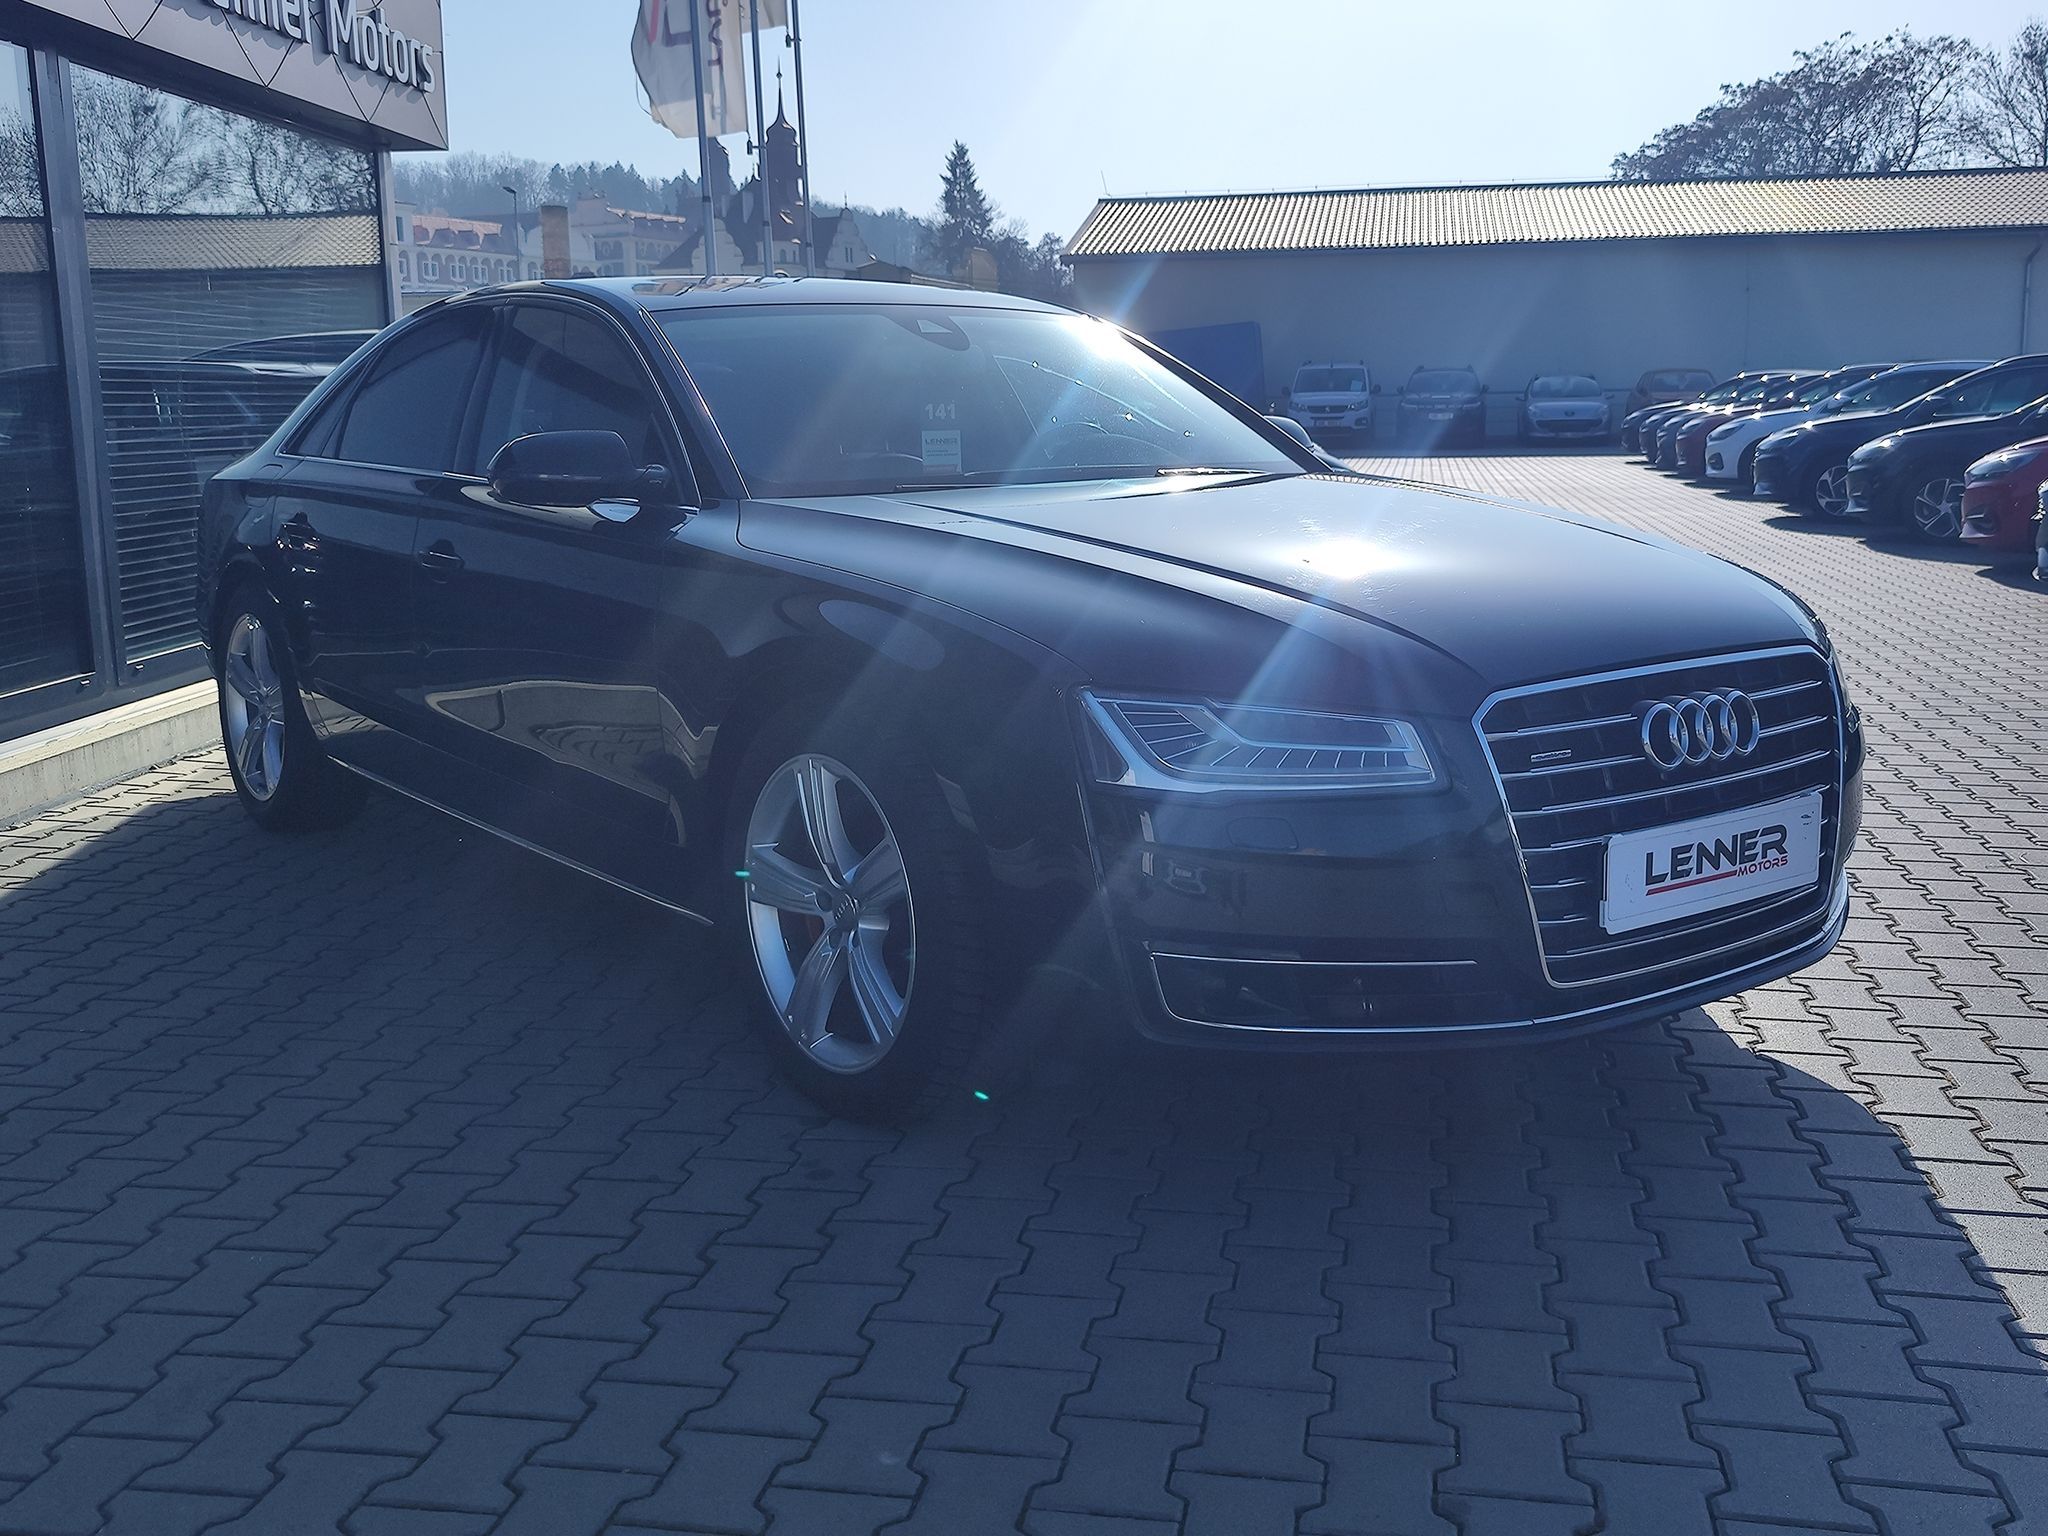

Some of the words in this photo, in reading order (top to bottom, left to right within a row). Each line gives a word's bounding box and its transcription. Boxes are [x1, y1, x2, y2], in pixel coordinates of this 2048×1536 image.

[327, 0, 436, 93] Motors
[925, 403, 956, 420] 141
[1645, 824, 1788, 886] LENNER
[1737, 855, 1789, 877] MOTORS
